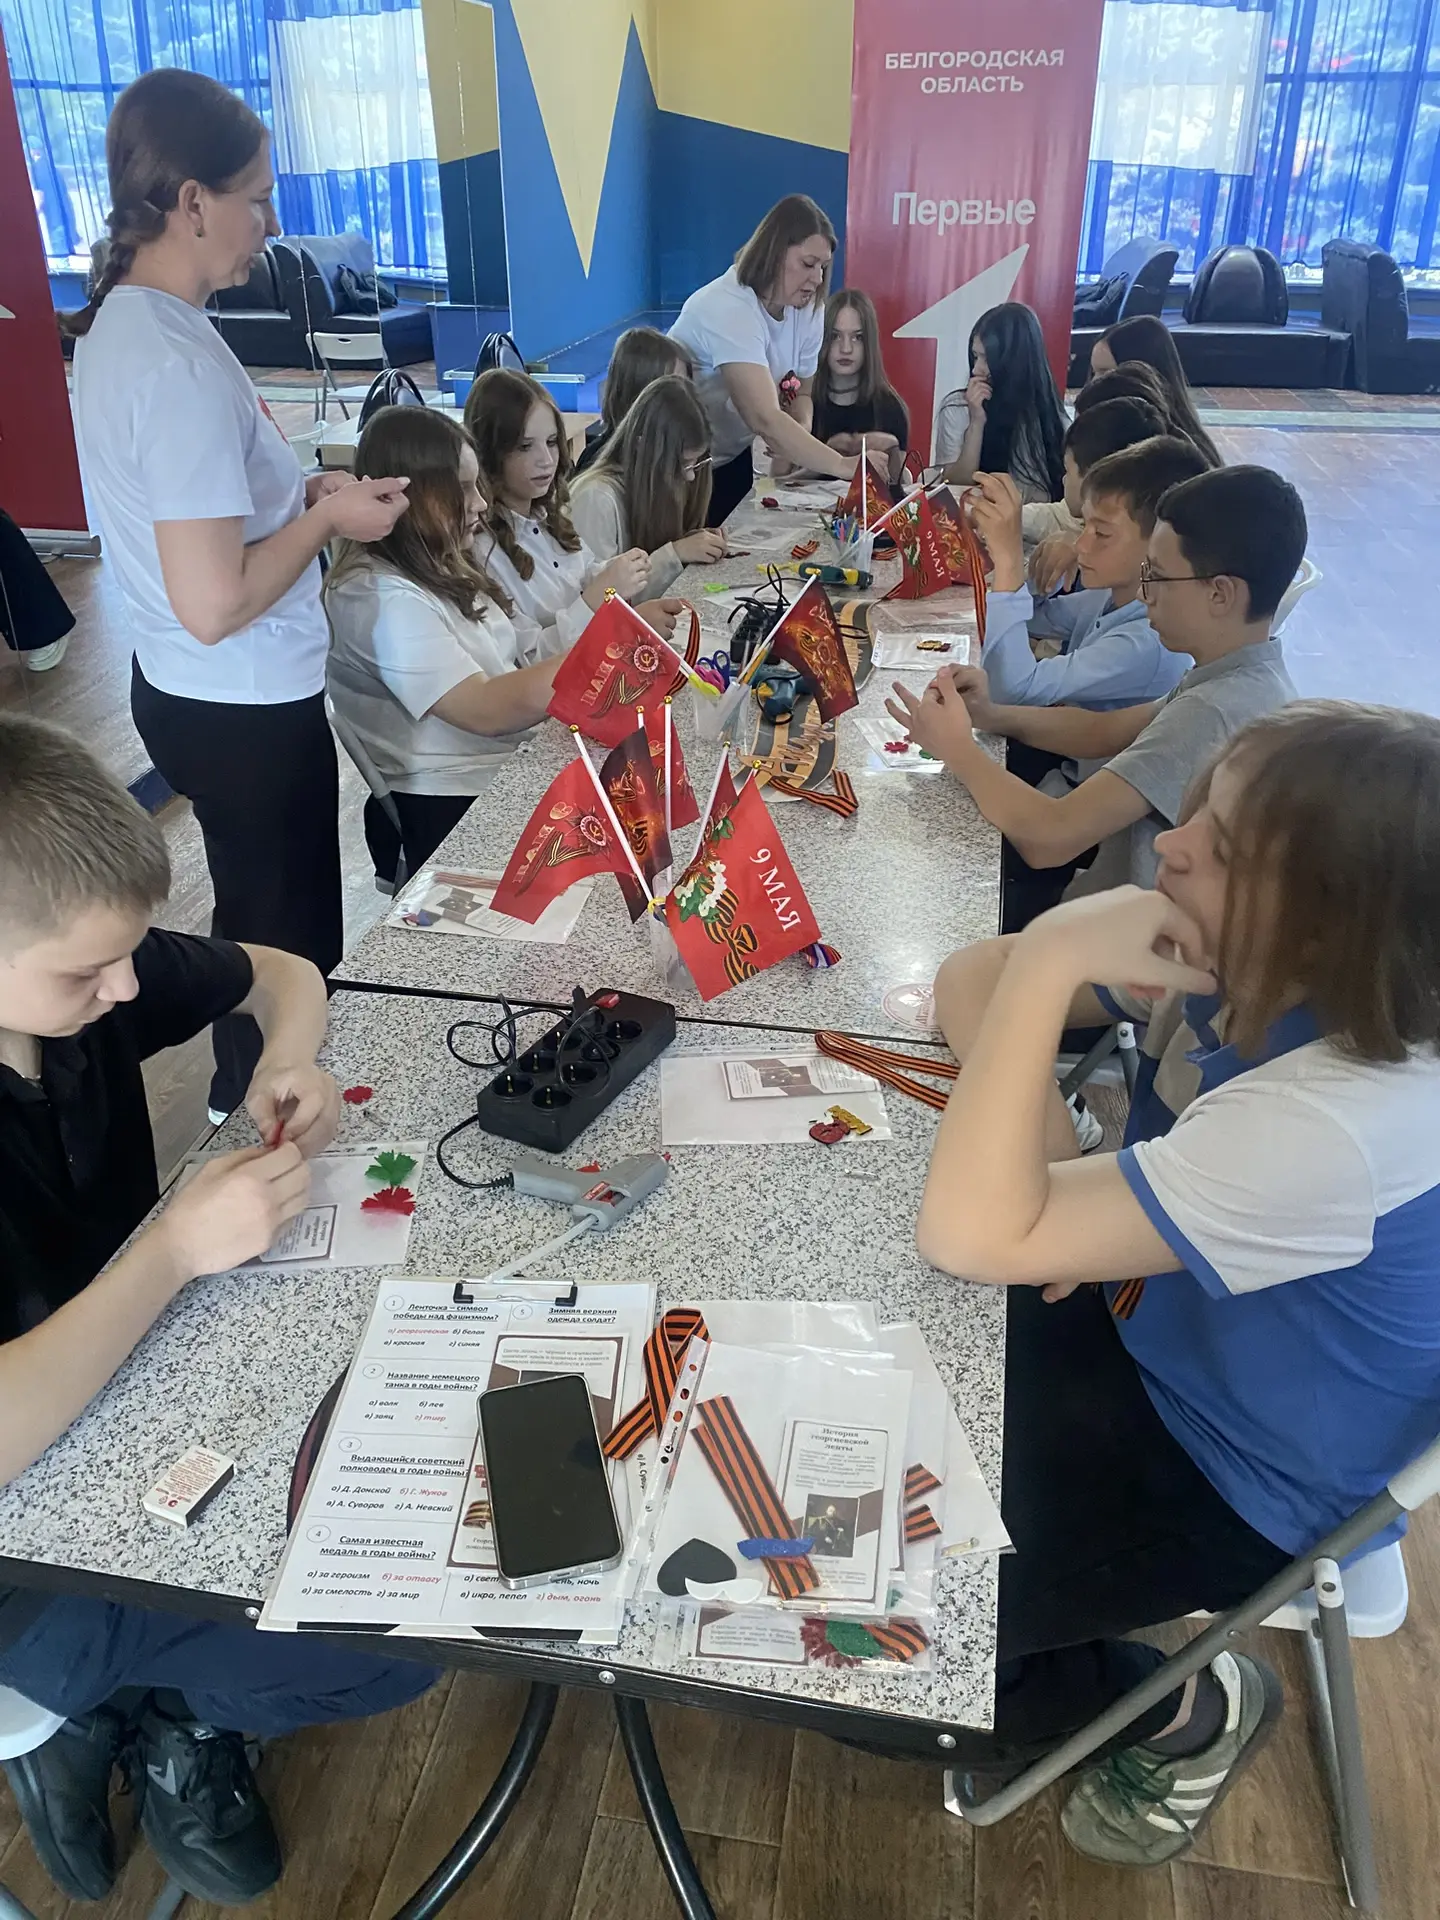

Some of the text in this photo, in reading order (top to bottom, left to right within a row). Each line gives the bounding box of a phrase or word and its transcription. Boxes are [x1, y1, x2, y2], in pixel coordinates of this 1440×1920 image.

[885, 48, 1065, 70] БЕЛГОРОДСКАЯ
[920, 75, 1024, 94] ОБЛАСТЬ
[892, 192, 1036, 236] Первые
[926, 530, 945, 578] 9 МАЯ
[749, 848, 801, 932] 9 МАЯ
[408, 1303, 447, 1311] Ленточка
[582, 1308, 617, 1316] верхняя
[393, 1312, 427, 1320] победы
[446, 1313, 499, 1321] фашизмом?
[387, 1372, 480, 1382] Название немецкого
[443, 1383, 478, 1391] войны?
[821, 1427, 859, 1438] История
[824, 1443, 853, 1452] ленты
[351, 1454, 465, 1466] Выдающийся советский
[340, 1465, 397, 1474] полководец
[407, 1467, 431, 1475] годы
[352, 1486, 391, 1494] Донской
[400, 1487, 409, 1495] б)
[418, 1489, 447, 1497] Жуков
[347, 1500, 384, 1509] Суворов
[416, 1503, 453, 1512] Невский
[339, 1535, 423, 1547] Самая известная
[320, 1546, 359, 1555] медаль
[369, 1549, 395, 1557] годы
[397, 1549, 436, 1559] войны?
[307, 1570, 318, 1578] а)
[330, 1571, 370, 1580] героизм
[381, 1572, 392, 1580] б)
[406, 1575, 442, 1584] отвагу
[464, 1574, 474, 1582] а)
[301, 1586, 312, 1594] в)
[325, 1588, 373, 1596] смелость
[376, 1589, 386, 1597] г)
[399, 1591, 420, 1599] мир
[471, 1592, 497, 1600] икра,
[546, 1592, 571, 1602] дым,
